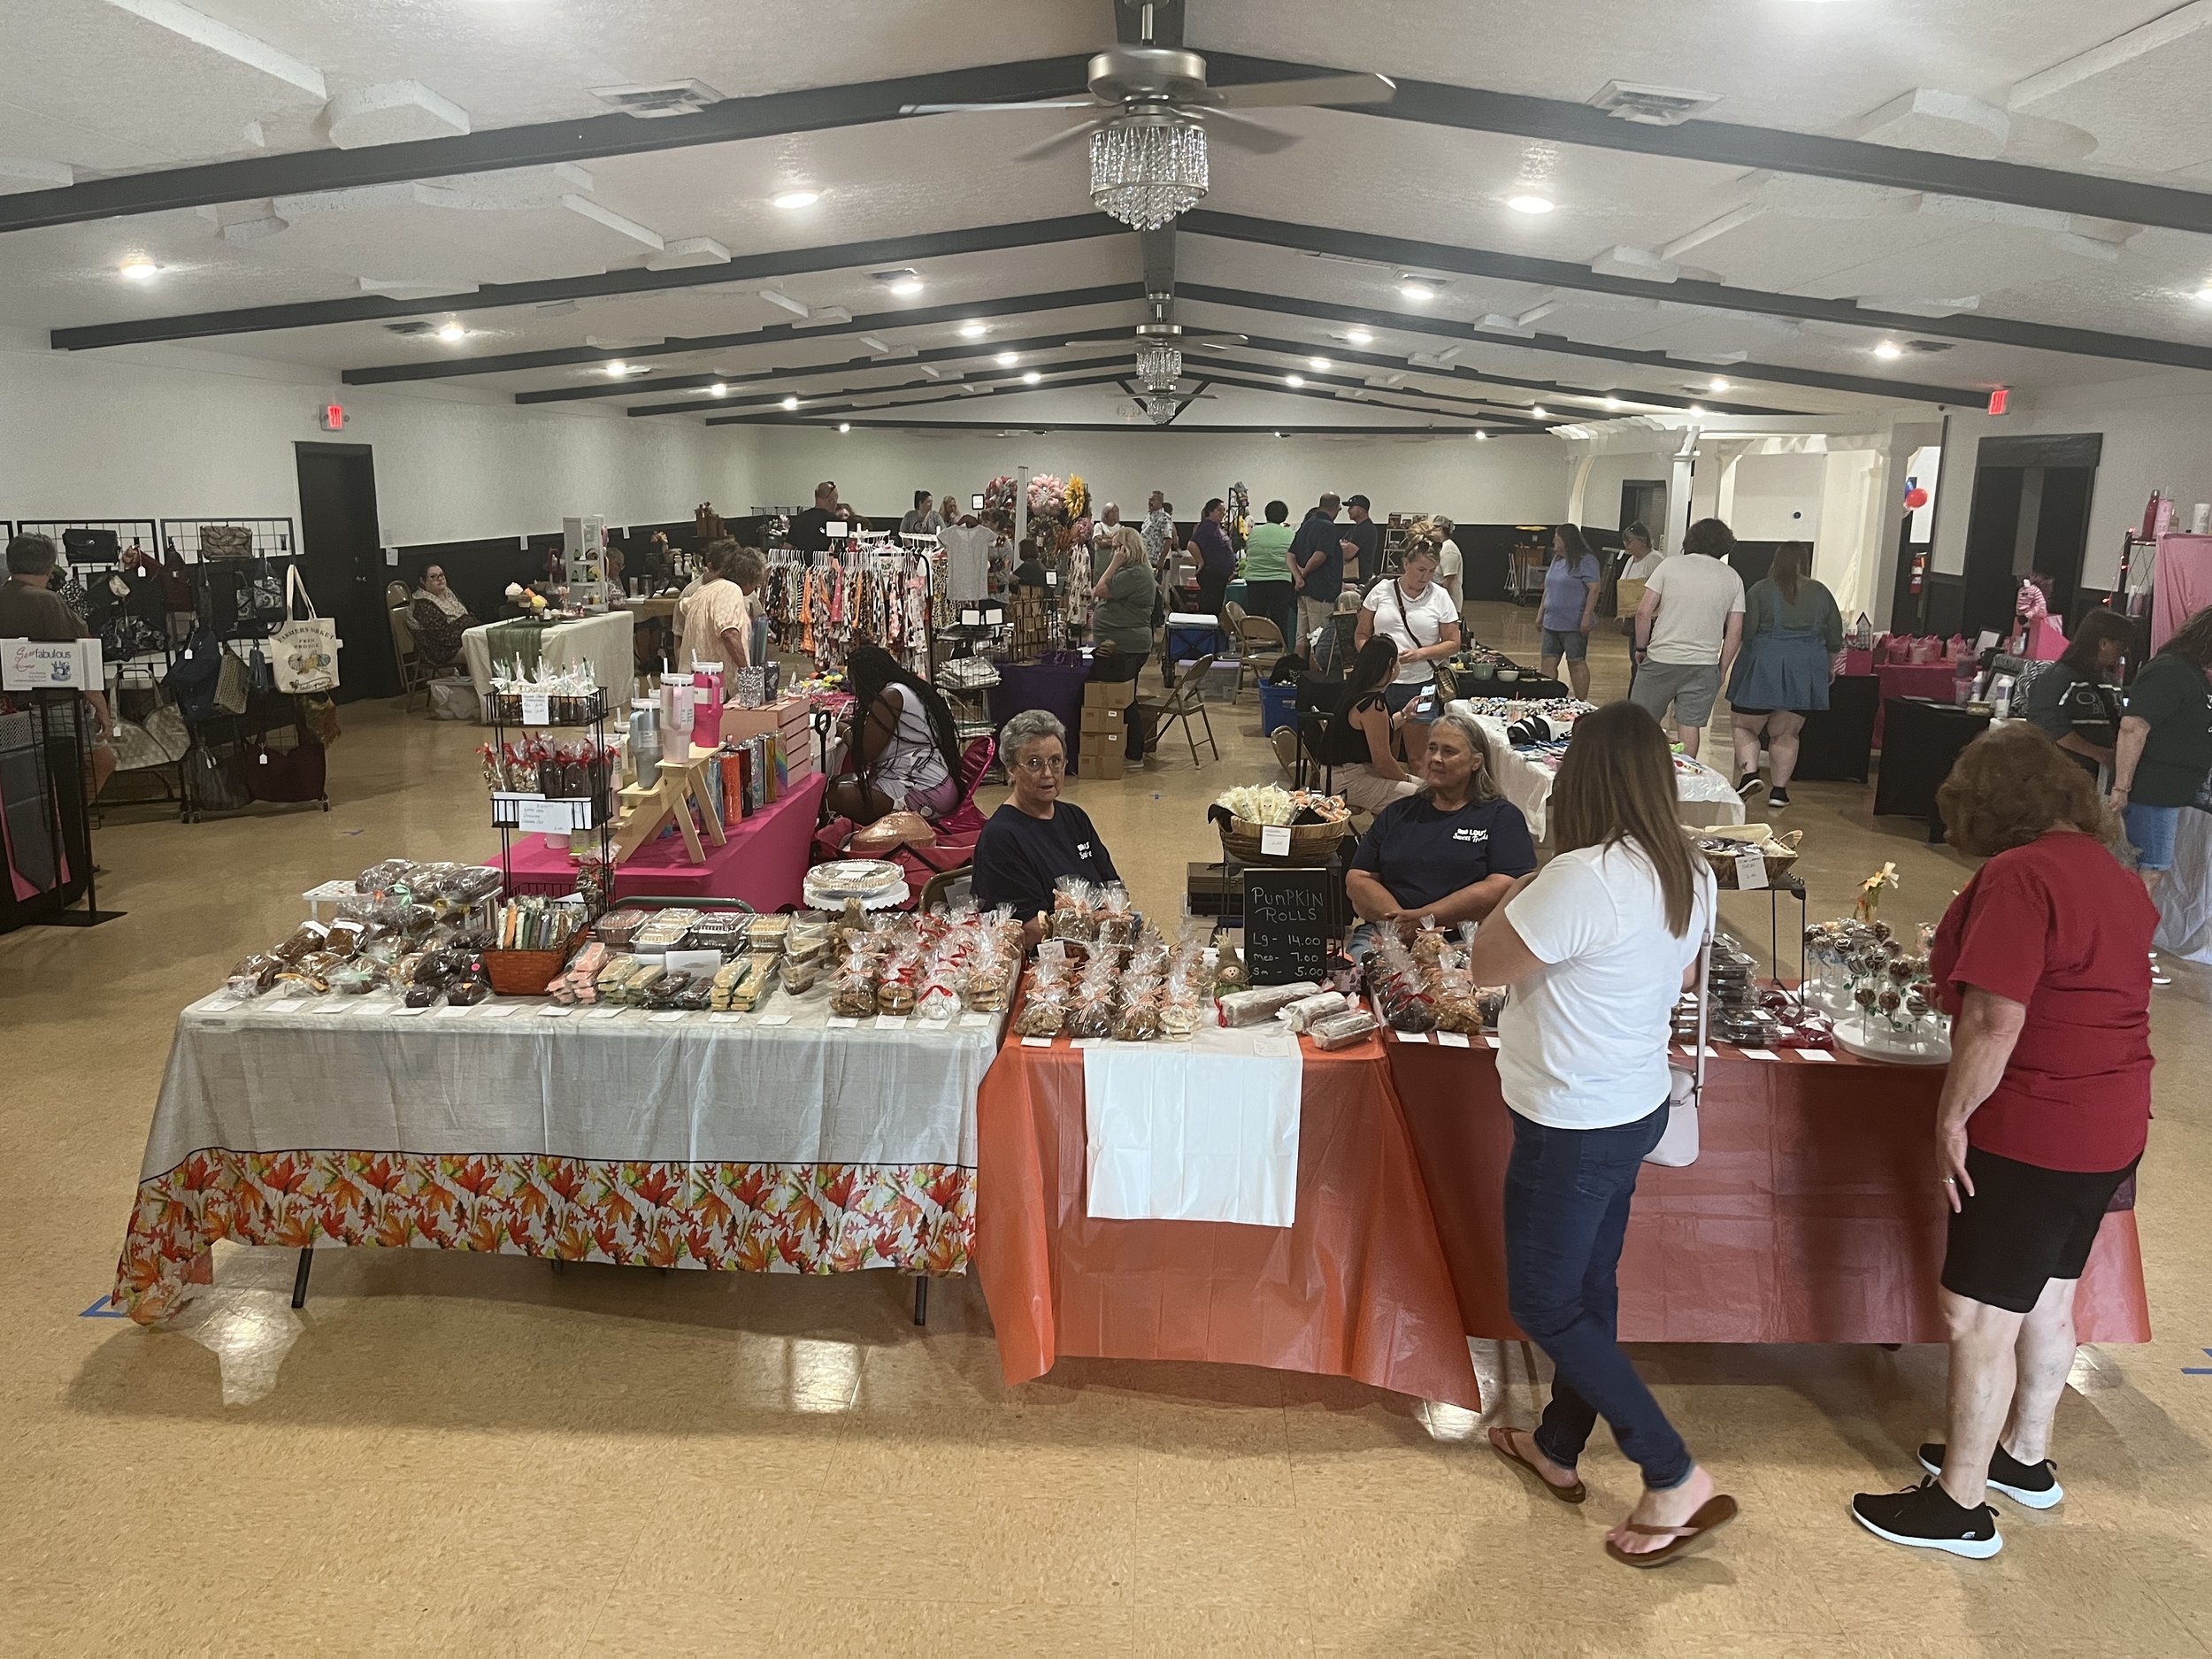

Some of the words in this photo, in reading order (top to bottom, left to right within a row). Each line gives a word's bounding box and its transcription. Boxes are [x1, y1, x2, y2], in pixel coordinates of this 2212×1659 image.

[35, 649, 71, 658] fabulous
[1255, 907, 1317, 924] ROLLS
[1253, 932, 1268, 947] Lg
[1288, 934, 1321, 947] 14.00
[1290, 952, 1318, 962] 7.00
[1294, 966, 1324, 977] 5.00
